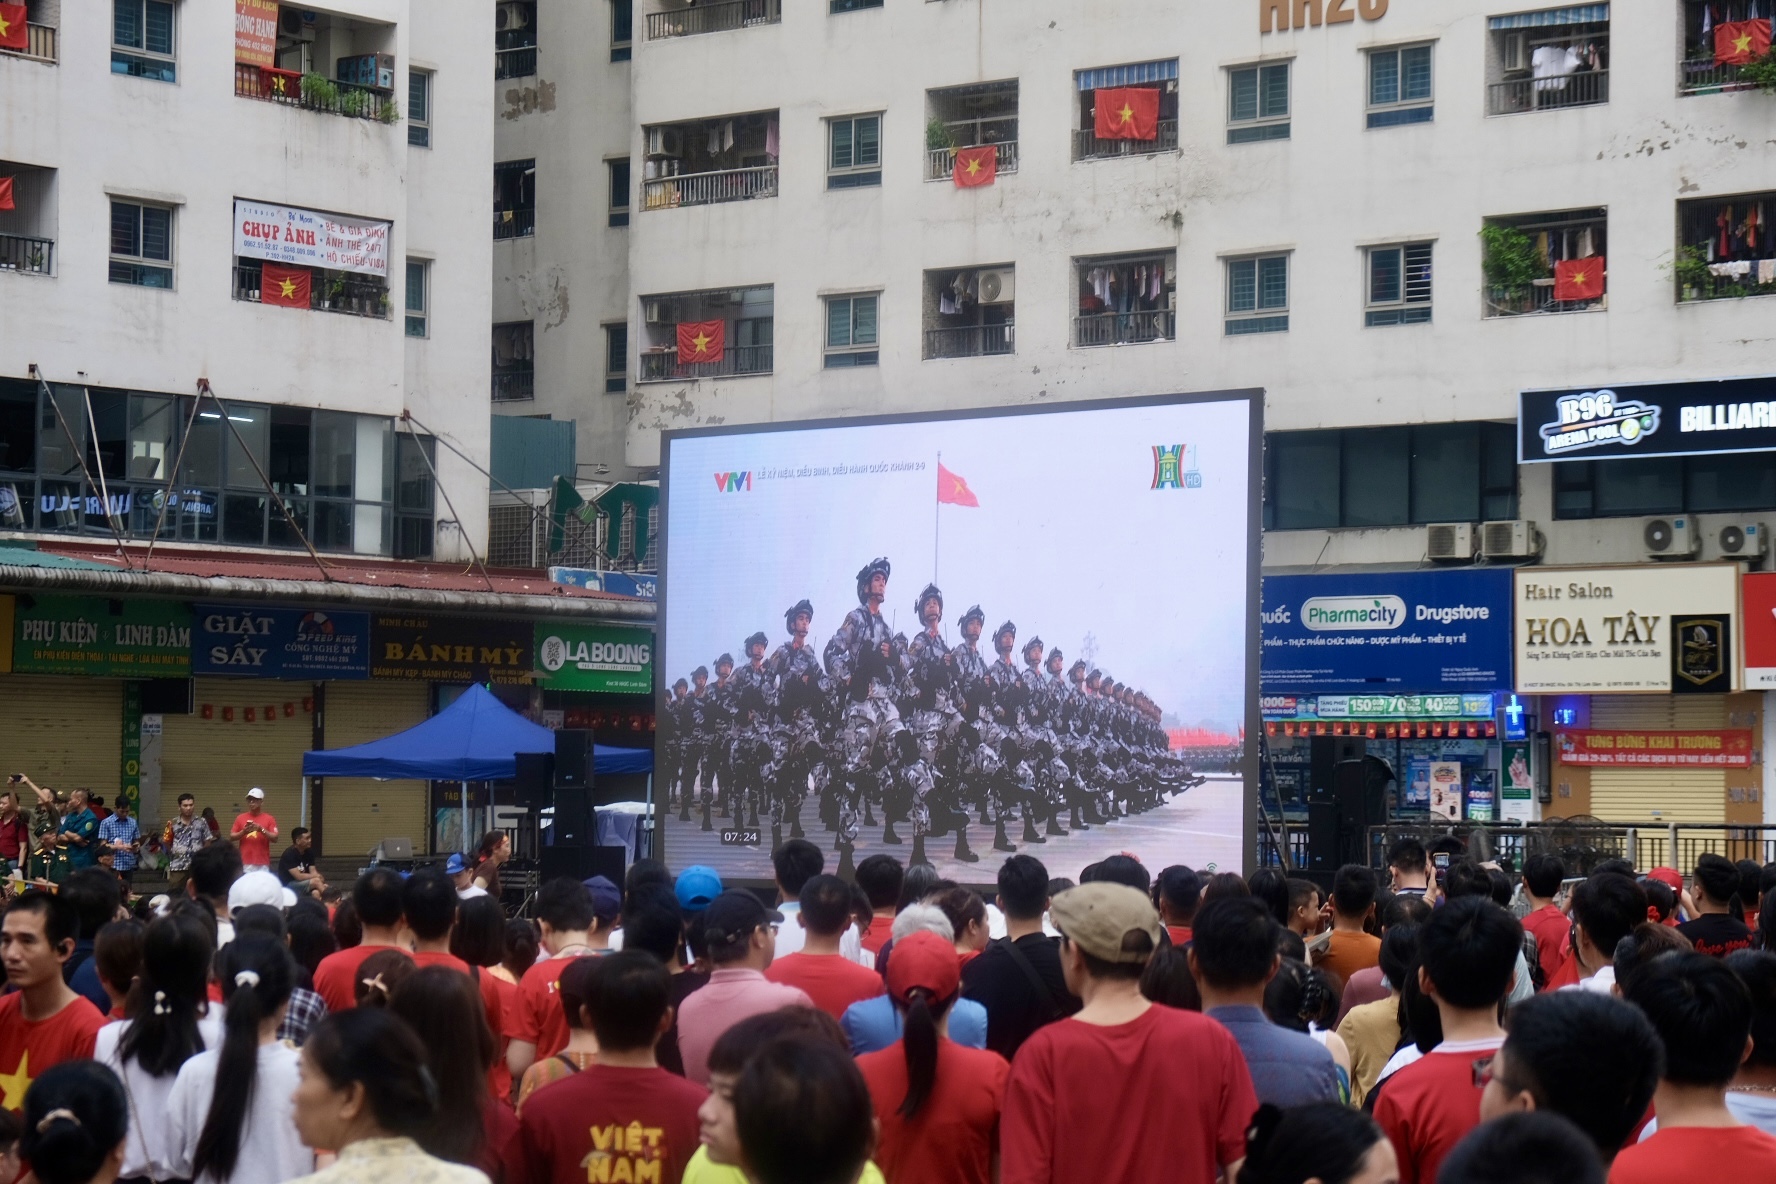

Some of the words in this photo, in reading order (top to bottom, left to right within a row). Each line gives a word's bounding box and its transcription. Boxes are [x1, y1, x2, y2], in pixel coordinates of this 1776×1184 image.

[242, 220, 280, 243] CHỤP
[284, 221, 316, 246] ẢNH
[326, 233, 343, 248] ẢNH
[348, 225, 362, 236] GIA
[1560, 393, 1613, 425] B96
[1549, 431, 1590, 450] ARENA
[1589, 423, 1620, 441] POOL
[714, 471, 751, 493] VTV1
[1525, 584, 1562, 600] Hair
[1568, 582, 1613, 599] Salon
[378, 617, 400, 628] MINH
[1309, 600, 1397, 625] Pharmacity
[1416, 604, 1490, 624] Drugstore
[22, 619, 56, 647] PHỤ
[59, 617, 98, 648] KIỆN
[115, 624, 153, 646] LINH
[156, 622, 191, 648] ĐÀM
[204, 611, 275, 640] GIẶT
[1526, 617, 1592, 646] HOA
[1602, 609, 1661, 645] TÂY
[285, 641, 310, 652] CÔNG
[312, 643, 340, 655] NGHỆ
[342, 645, 357, 655] MỸ
[385, 635, 475, 664] BÁNH
[479, 640, 524, 666] MỲ
[1453, 635, 1459, 643] Y
[1350, 699, 1373, 711] 150
[1388, 698, 1406, 711] 70
[1425, 698, 1443, 711] 40
[1648, 736, 1675, 748] KHAI
[724, 832, 757, 841] 07:24
[589, 1120, 664, 1156] VIỆT
[588, 1157, 661, 1184] NAM
